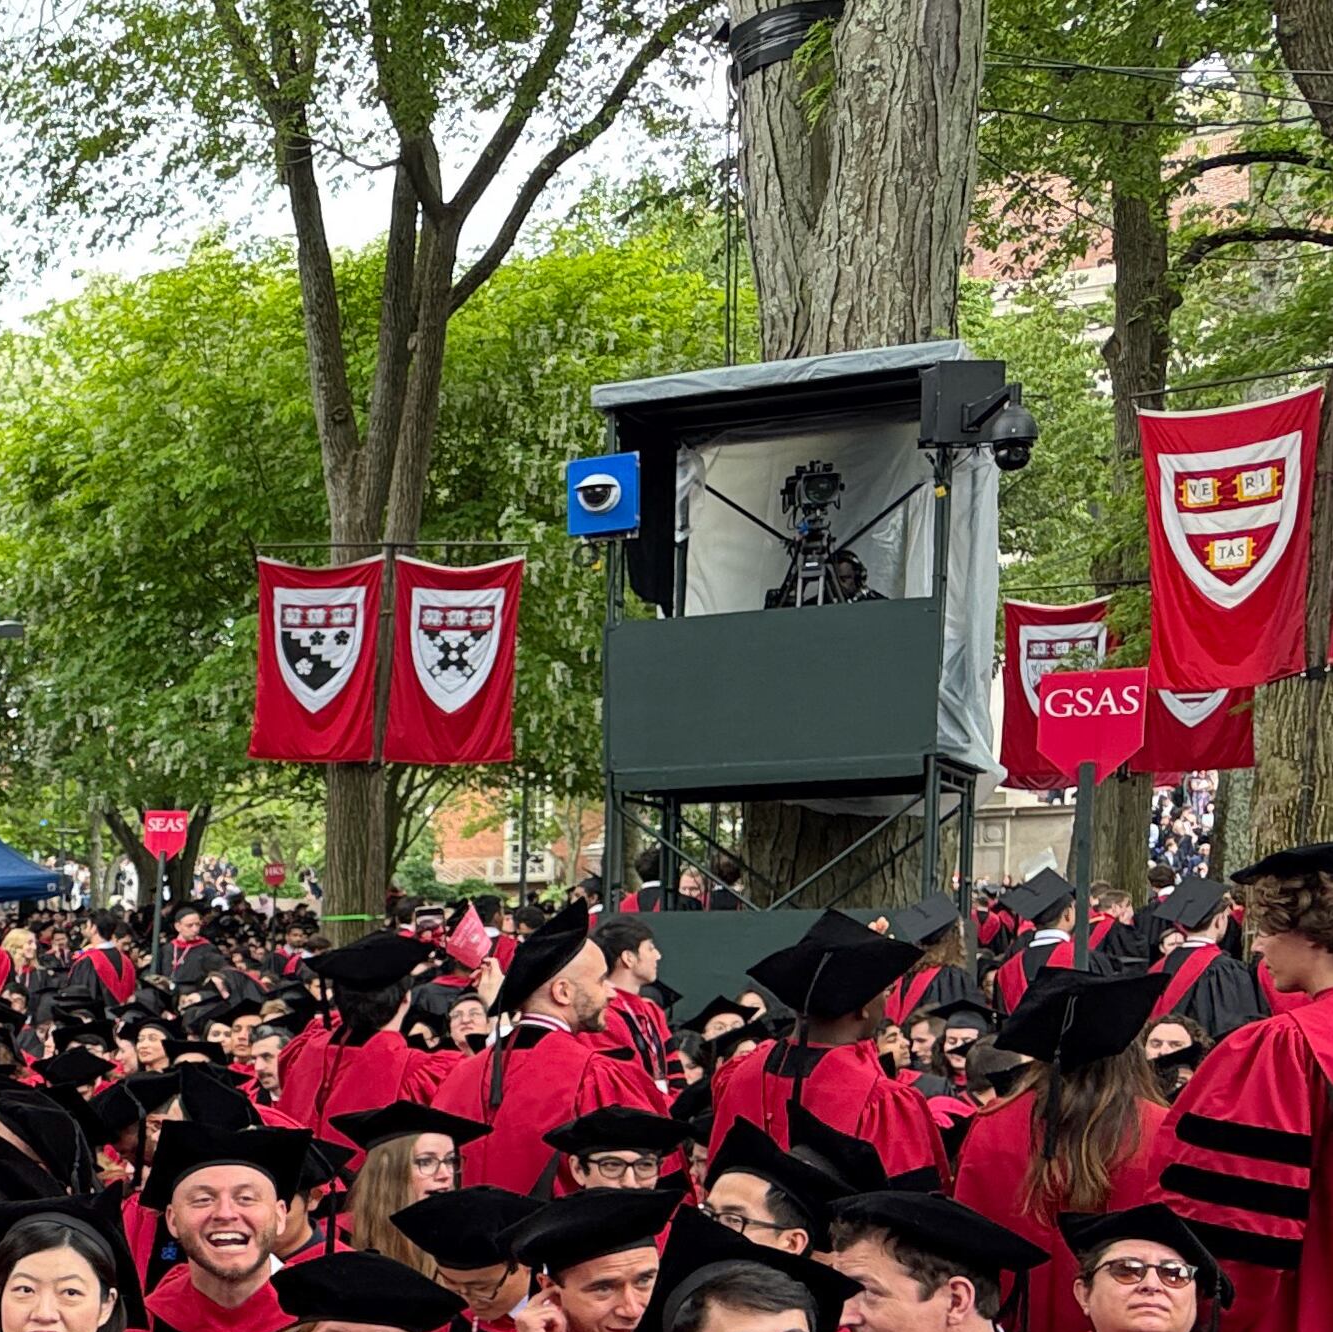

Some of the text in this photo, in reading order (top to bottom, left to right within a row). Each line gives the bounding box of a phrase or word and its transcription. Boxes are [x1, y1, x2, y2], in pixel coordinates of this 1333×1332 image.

[1188, 474, 1266, 496] VE RI
[1218, 544, 1245, 560] TAS
[1044, 685, 1141, 718] GSAS
[147, 817, 185, 833] SEAS
